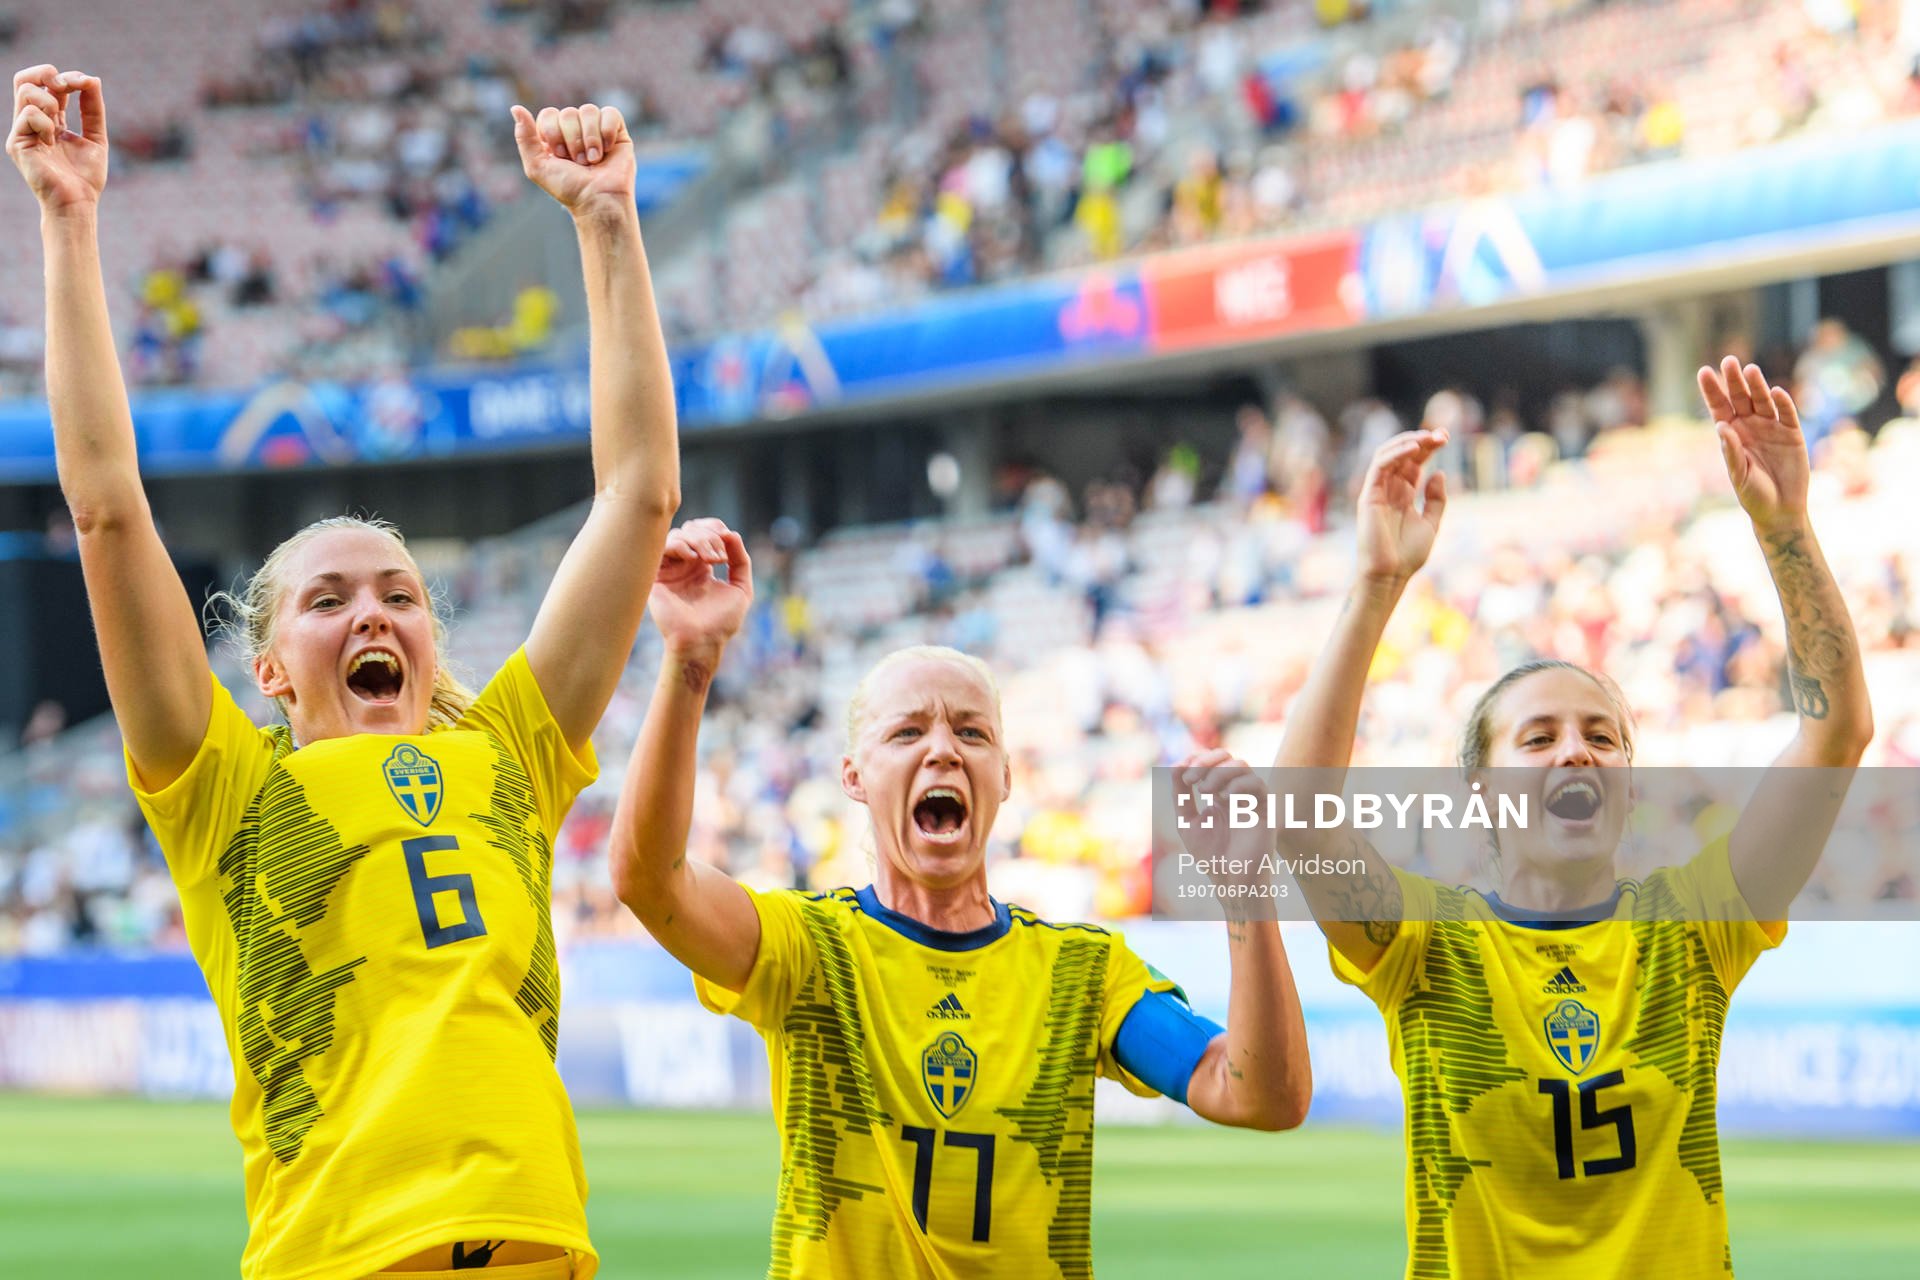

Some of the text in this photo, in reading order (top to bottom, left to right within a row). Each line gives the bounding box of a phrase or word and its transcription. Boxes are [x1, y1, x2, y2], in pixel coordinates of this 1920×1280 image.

[401, 835, 487, 950] 6
[926, 1008, 971, 1019] adidas
[1542, 984, 1587, 994] adidas
[1538, 1069, 1636, 1180] 15
[901, 1124, 995, 1242] 17
